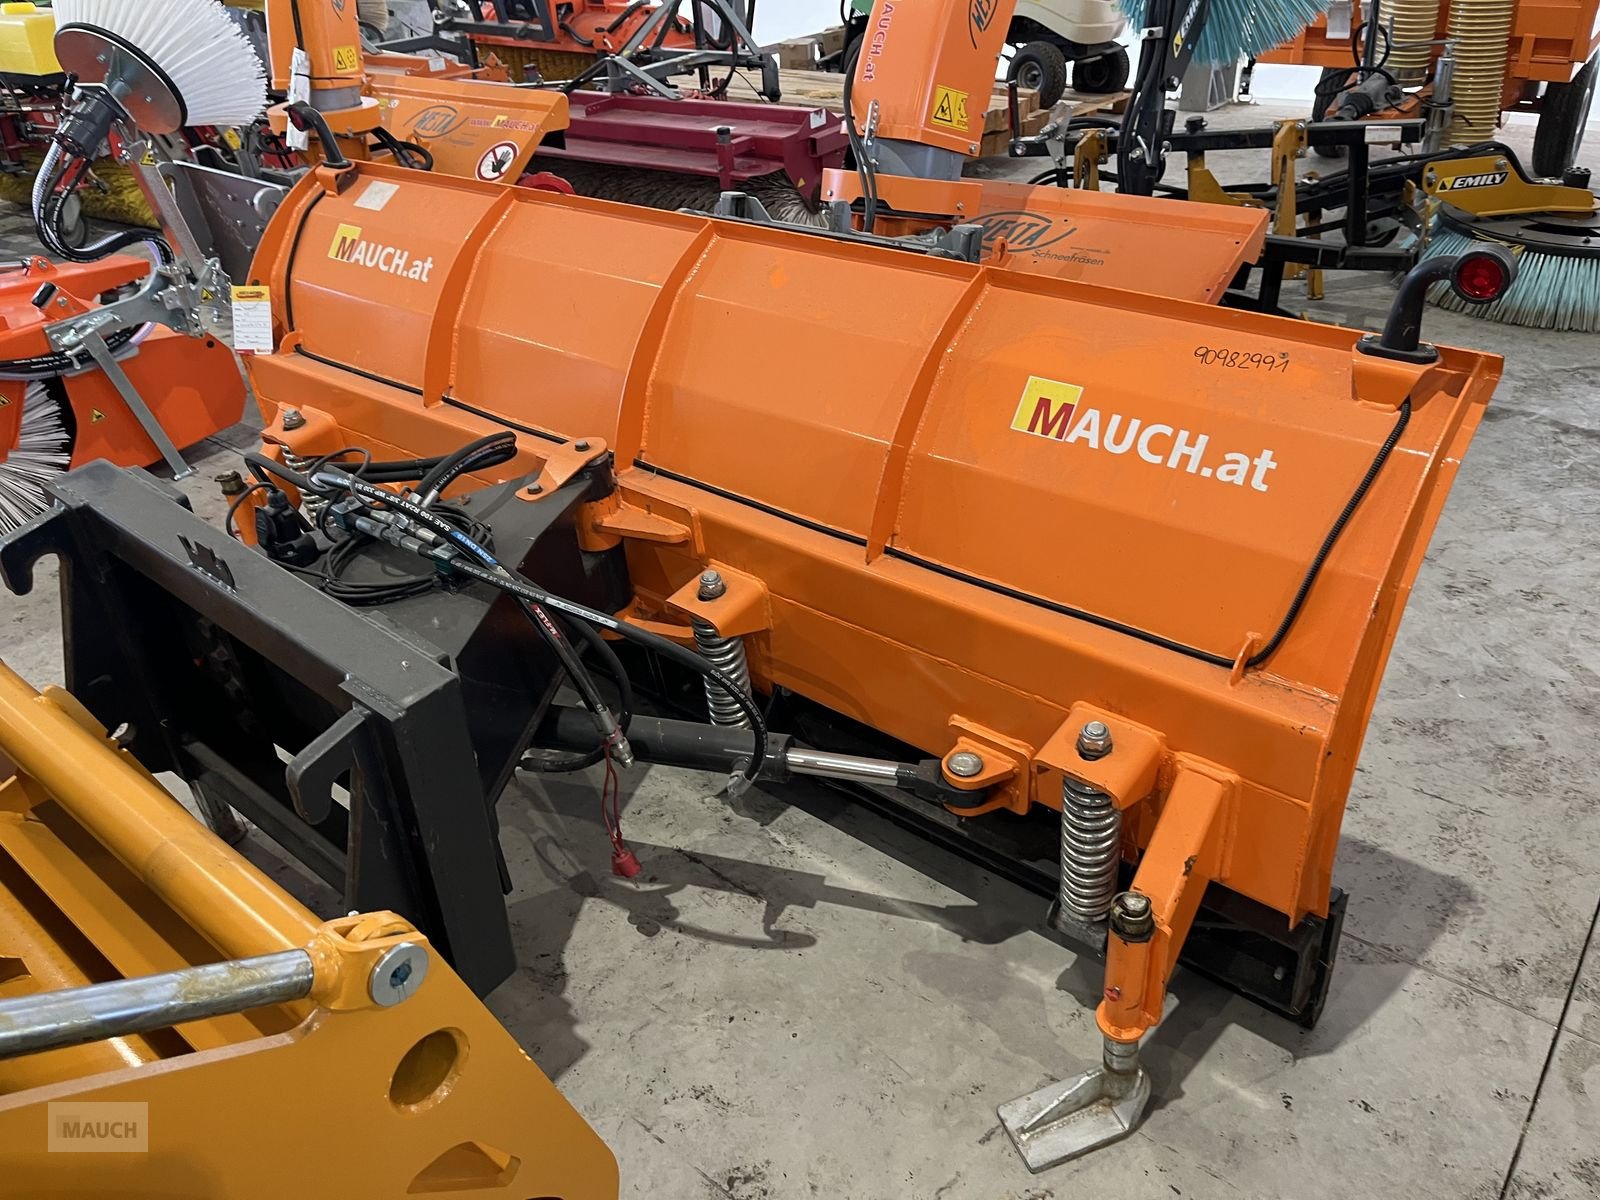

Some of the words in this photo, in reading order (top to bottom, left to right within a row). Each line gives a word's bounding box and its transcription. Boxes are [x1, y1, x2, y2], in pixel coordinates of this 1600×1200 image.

[1452, 172, 1506, 189] EMILY
[335, 235, 434, 283] MAUCH.at
[1194, 346, 1290, 373] 90982991
[1027, 396, 1278, 493] MAUCH.at
[433, 518, 452, 532] SAE
